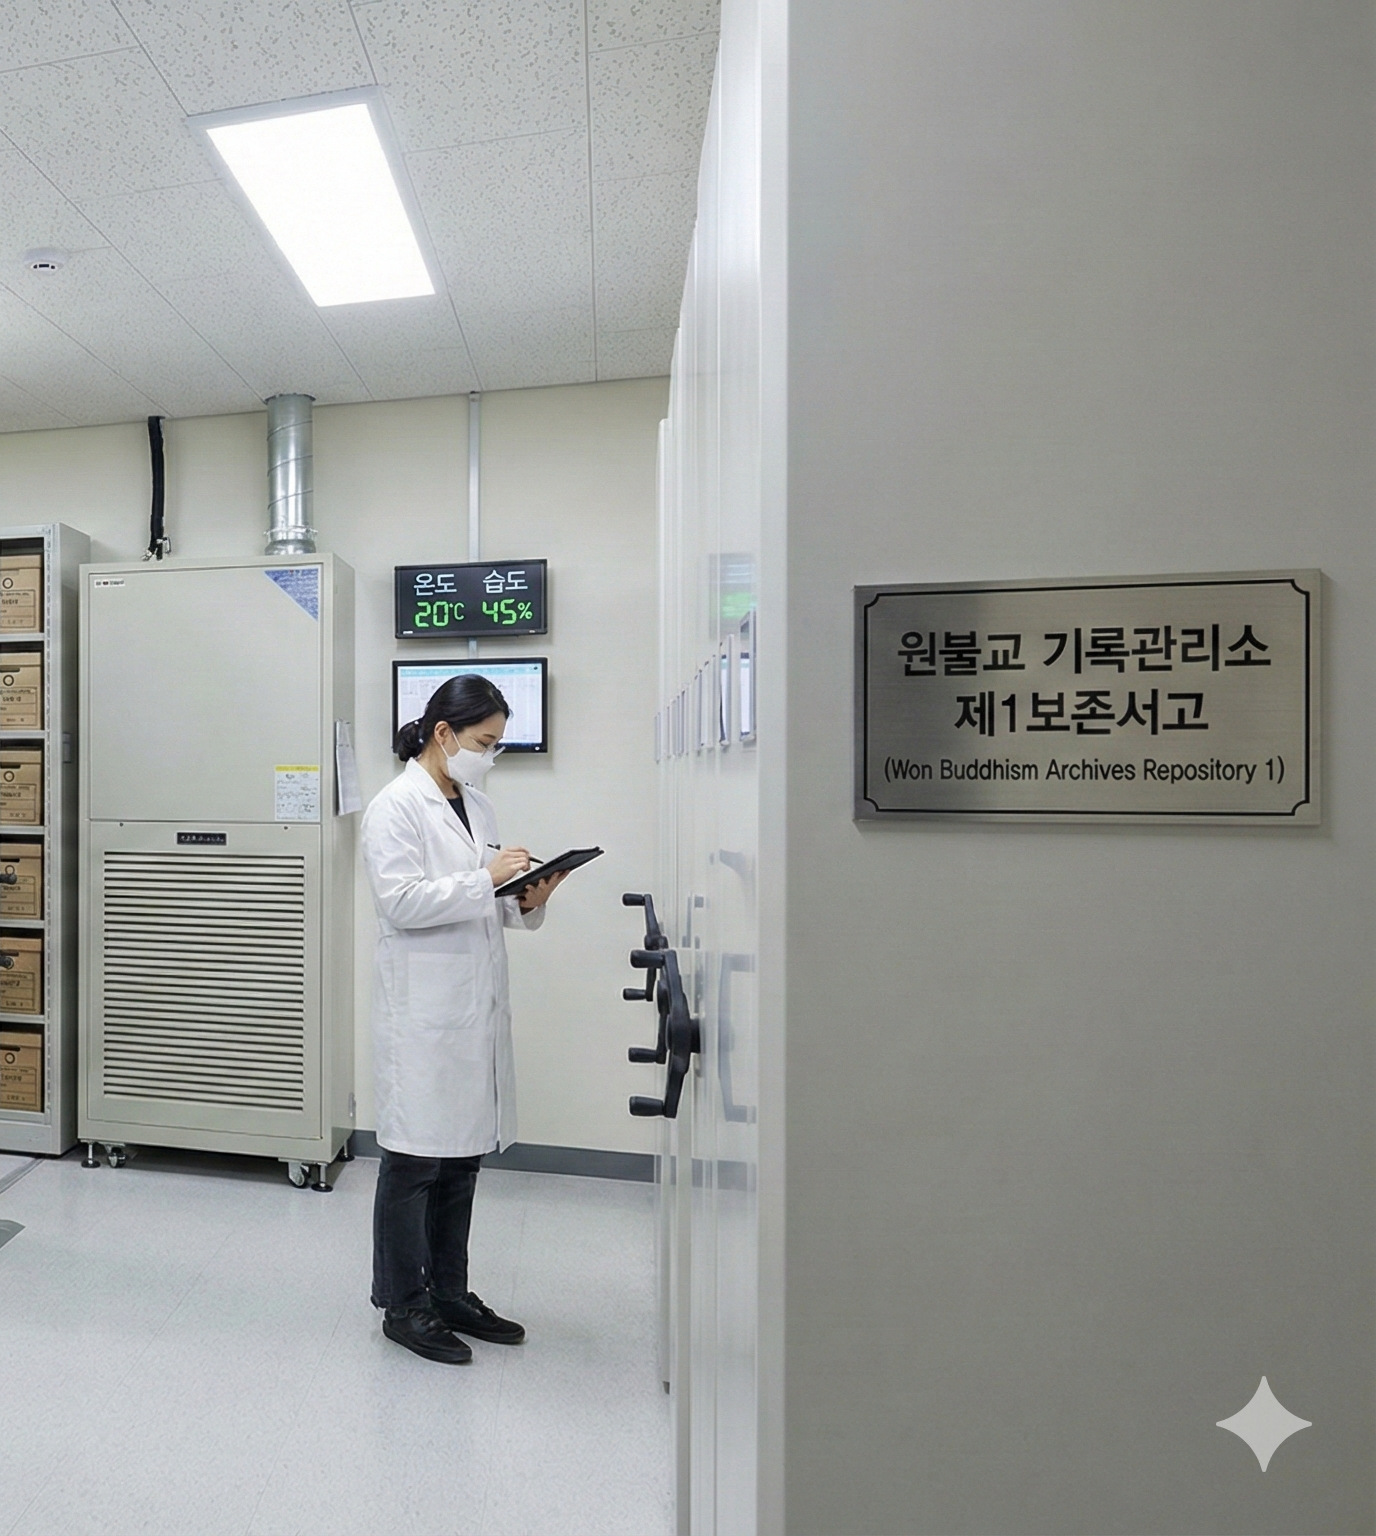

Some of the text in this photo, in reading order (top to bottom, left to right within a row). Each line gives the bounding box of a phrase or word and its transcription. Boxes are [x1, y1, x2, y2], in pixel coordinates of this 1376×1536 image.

[413, 569, 528, 596] 온도 습도
[482, 598, 533, 625] 45%
[897, 623, 1272, 677] 원불교 기록관리소
[954, 688, 1210, 737] 제1보존서고
[884, 756, 1286, 785] (Won Buddhism Archives Repository 1)
